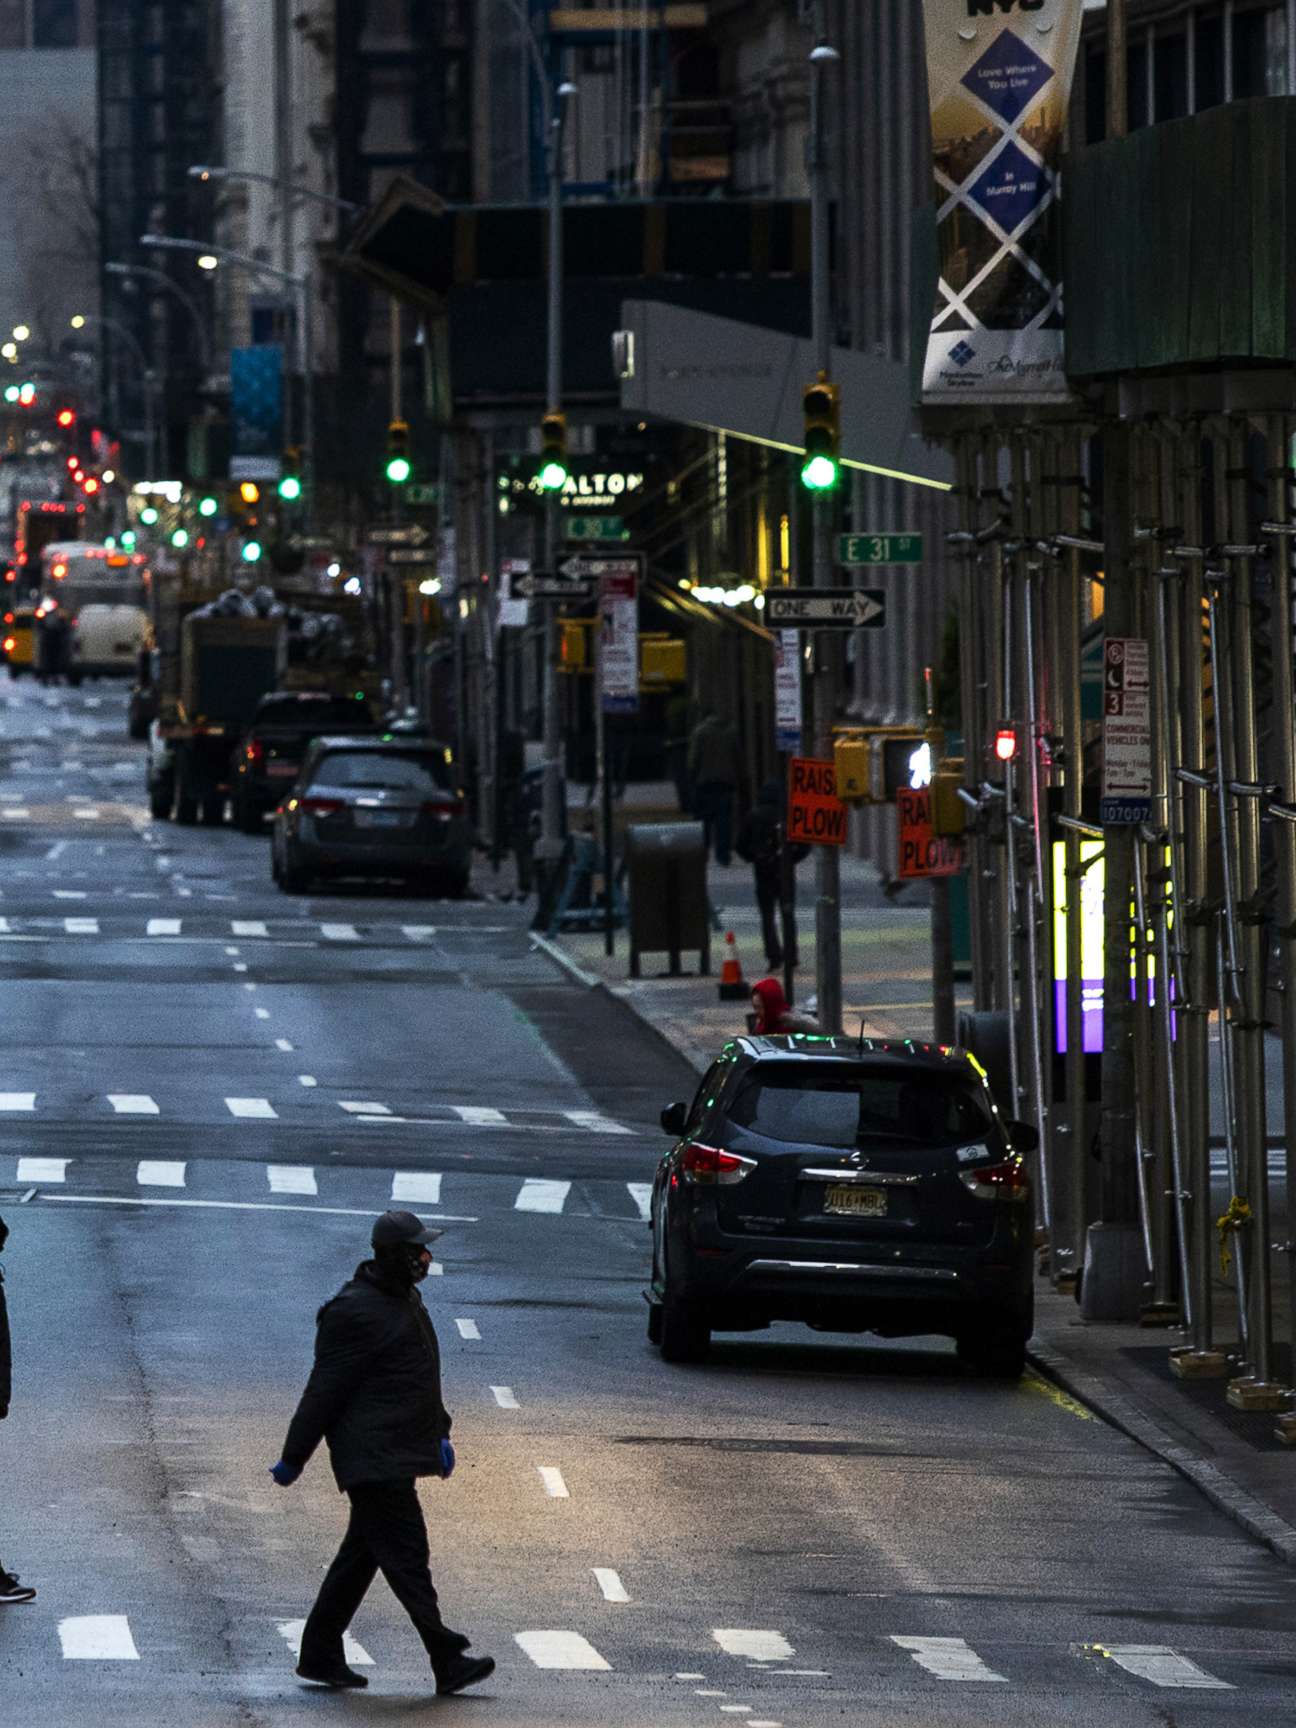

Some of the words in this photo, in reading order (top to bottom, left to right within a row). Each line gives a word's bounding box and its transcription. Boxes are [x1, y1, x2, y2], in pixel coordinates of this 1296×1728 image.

[978, 68, 1003, 78] Love
[1006, 64, 1036, 75] Where
[988, 79, 1008, 89] You
[1010, 77, 1029, 88] Live
[847, 538, 861, 561] E
[869, 537, 891, 561] 31
[774, 600, 810, 616] ONE
[831, 600, 870, 616] WAY
[1108, 694, 1120, 714] 3
[794, 765, 836, 797] RAIS
[792, 807, 845, 837] PLOW
